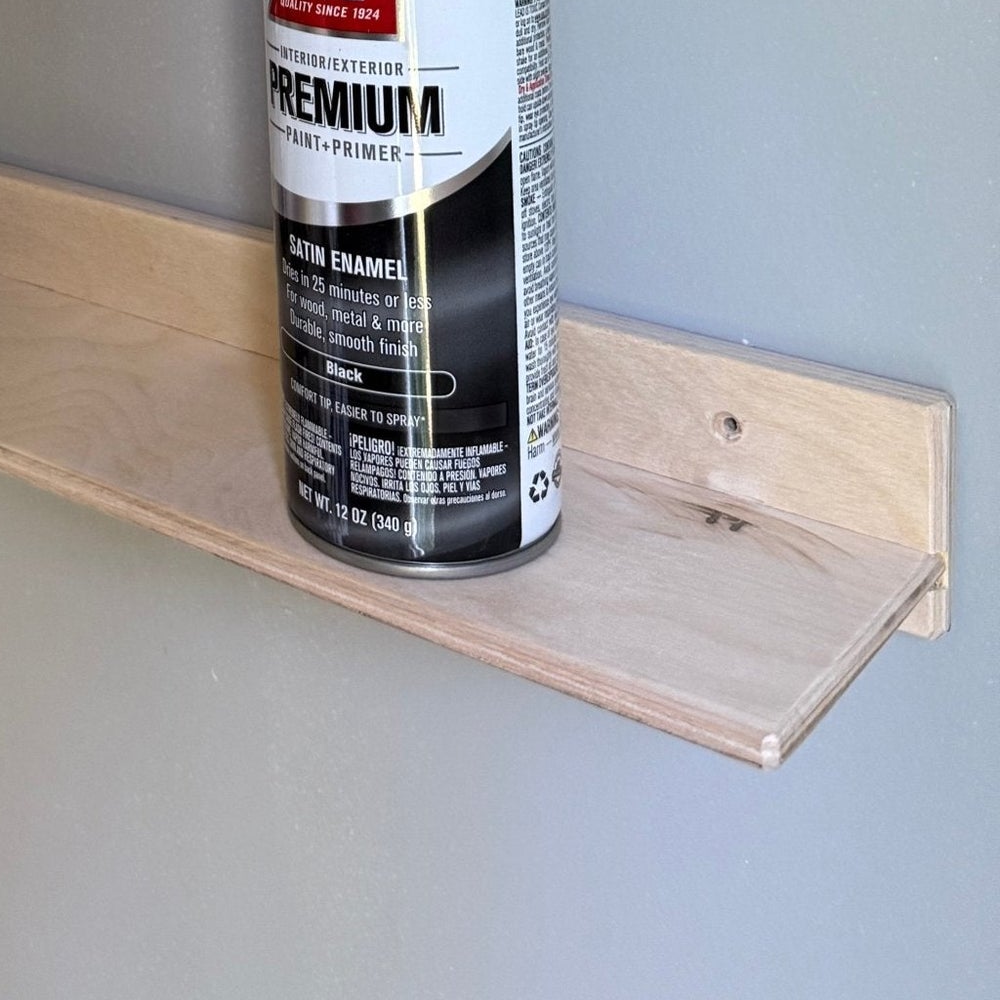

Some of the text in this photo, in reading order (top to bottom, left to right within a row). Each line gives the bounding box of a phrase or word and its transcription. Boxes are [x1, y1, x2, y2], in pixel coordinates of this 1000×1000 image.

[316, 3, 347, 18] SINCE
[353, 7, 380, 21] 1924
[280, 45, 404, 77] INTERIOR/EXTERIOR
[269, 59, 445, 137] PREMIUM
[286, 125, 401, 162] PAINT+PRIMER
[521, 193, 536, 208] SMOKE
[289, 233, 408, 281] SATIN ENAMEL
[282, 257, 432, 310] Dries in 25 minutes or less
[286, 283, 424, 334] For wood, metal & more
[290, 308, 418, 358] Durable, smooth finish
[326, 360, 363, 383] Black
[290, 377, 317, 404] COMFORT
[319, 394, 333, 414] TIP,
[336, 402, 368, 422] EASIER
[370, 411, 383, 424] TO
[527, 413, 536, 426] NOT
[349, 432, 395, 456] ¡PELIGRO!
[350, 448, 481, 471] LOS VAPORES PUEDEN CAUSAR FUEGOS
[398, 469, 438, 482] CONTENIDO
[439, 471, 445, 481] A
[479, 463, 507, 479] VAPORES
[350, 482, 402, 502] RESPIRATORIAS.
[430, 495, 446, 505] otras
[447, 493, 484, 506] precauciones
[485, 491, 491, 501] al
[381, 478, 404, 491] IRRITA
[405, 480, 419, 492] LOS
[443, 482, 458, 493] PIEL
[459, 481, 465, 492] Y
[299, 480, 418, 537] NET WT. 12 OZ (340 g)
